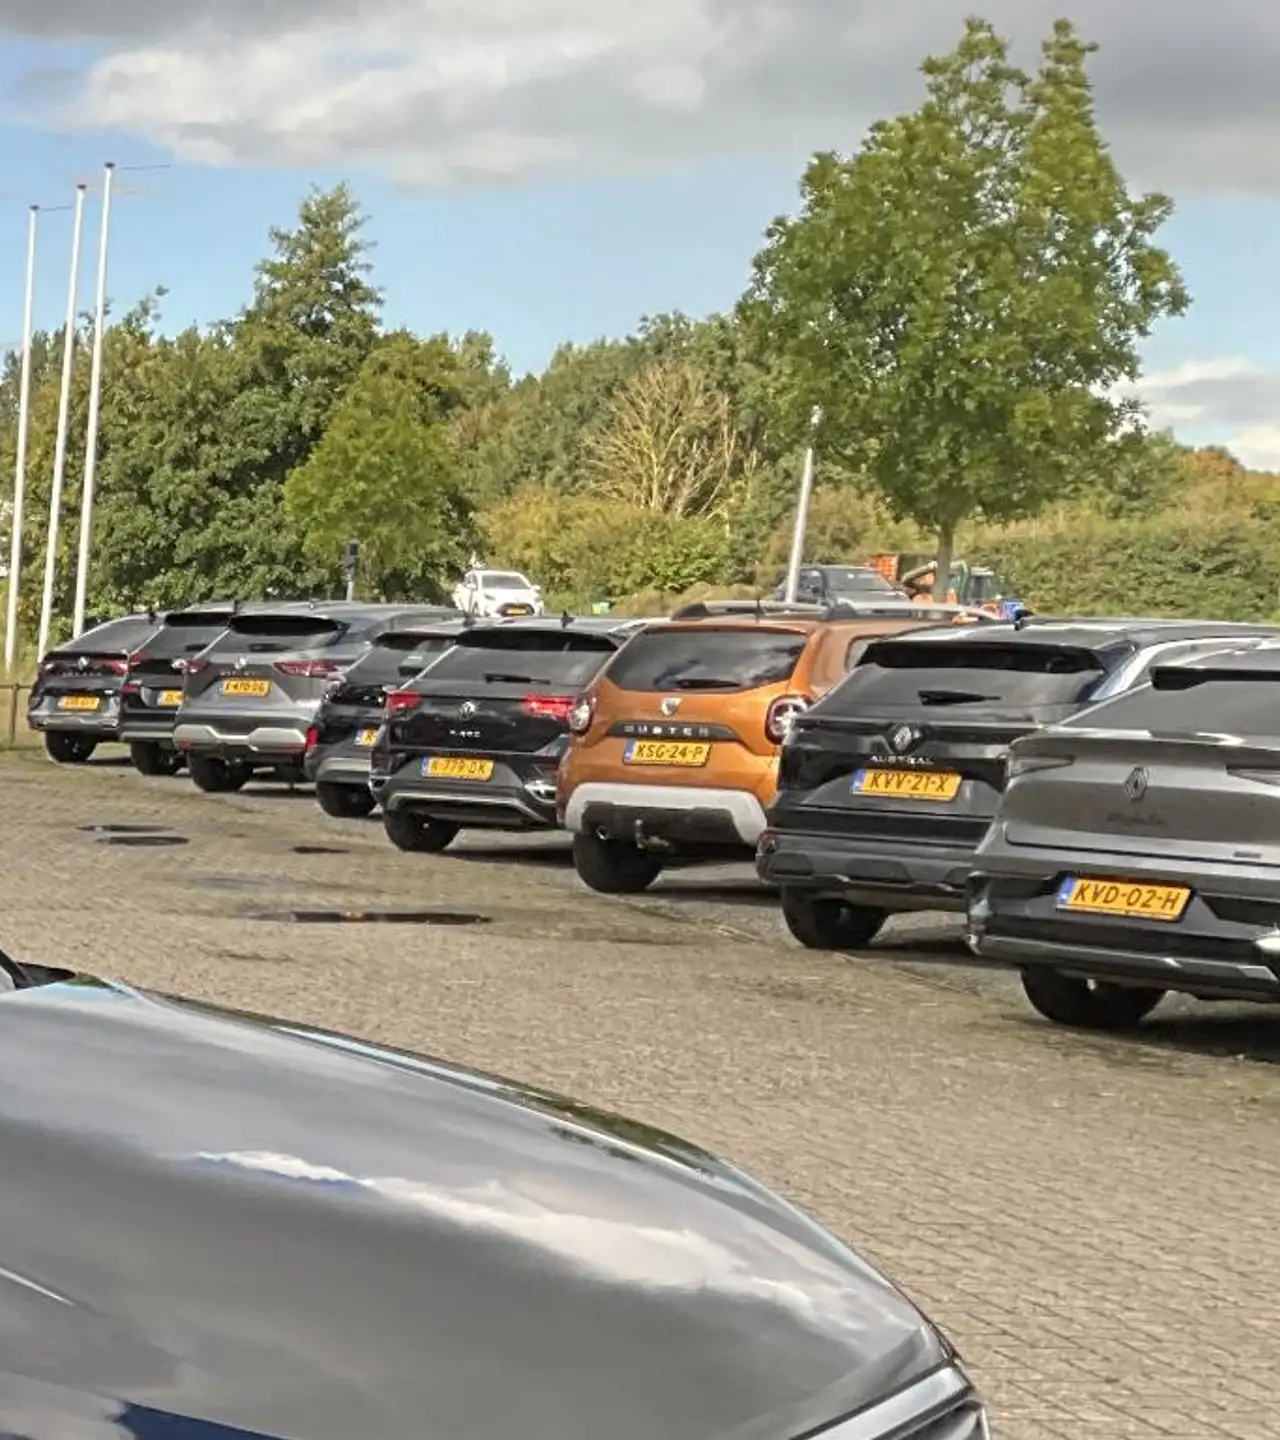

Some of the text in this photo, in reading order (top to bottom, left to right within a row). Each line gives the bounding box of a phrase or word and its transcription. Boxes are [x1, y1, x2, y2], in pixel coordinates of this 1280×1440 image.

[637, 744, 705, 761] KSG-24-P
[869, 771, 950, 792] KVV-21-X
[1073, 881, 1182, 910] KVD-02-H
